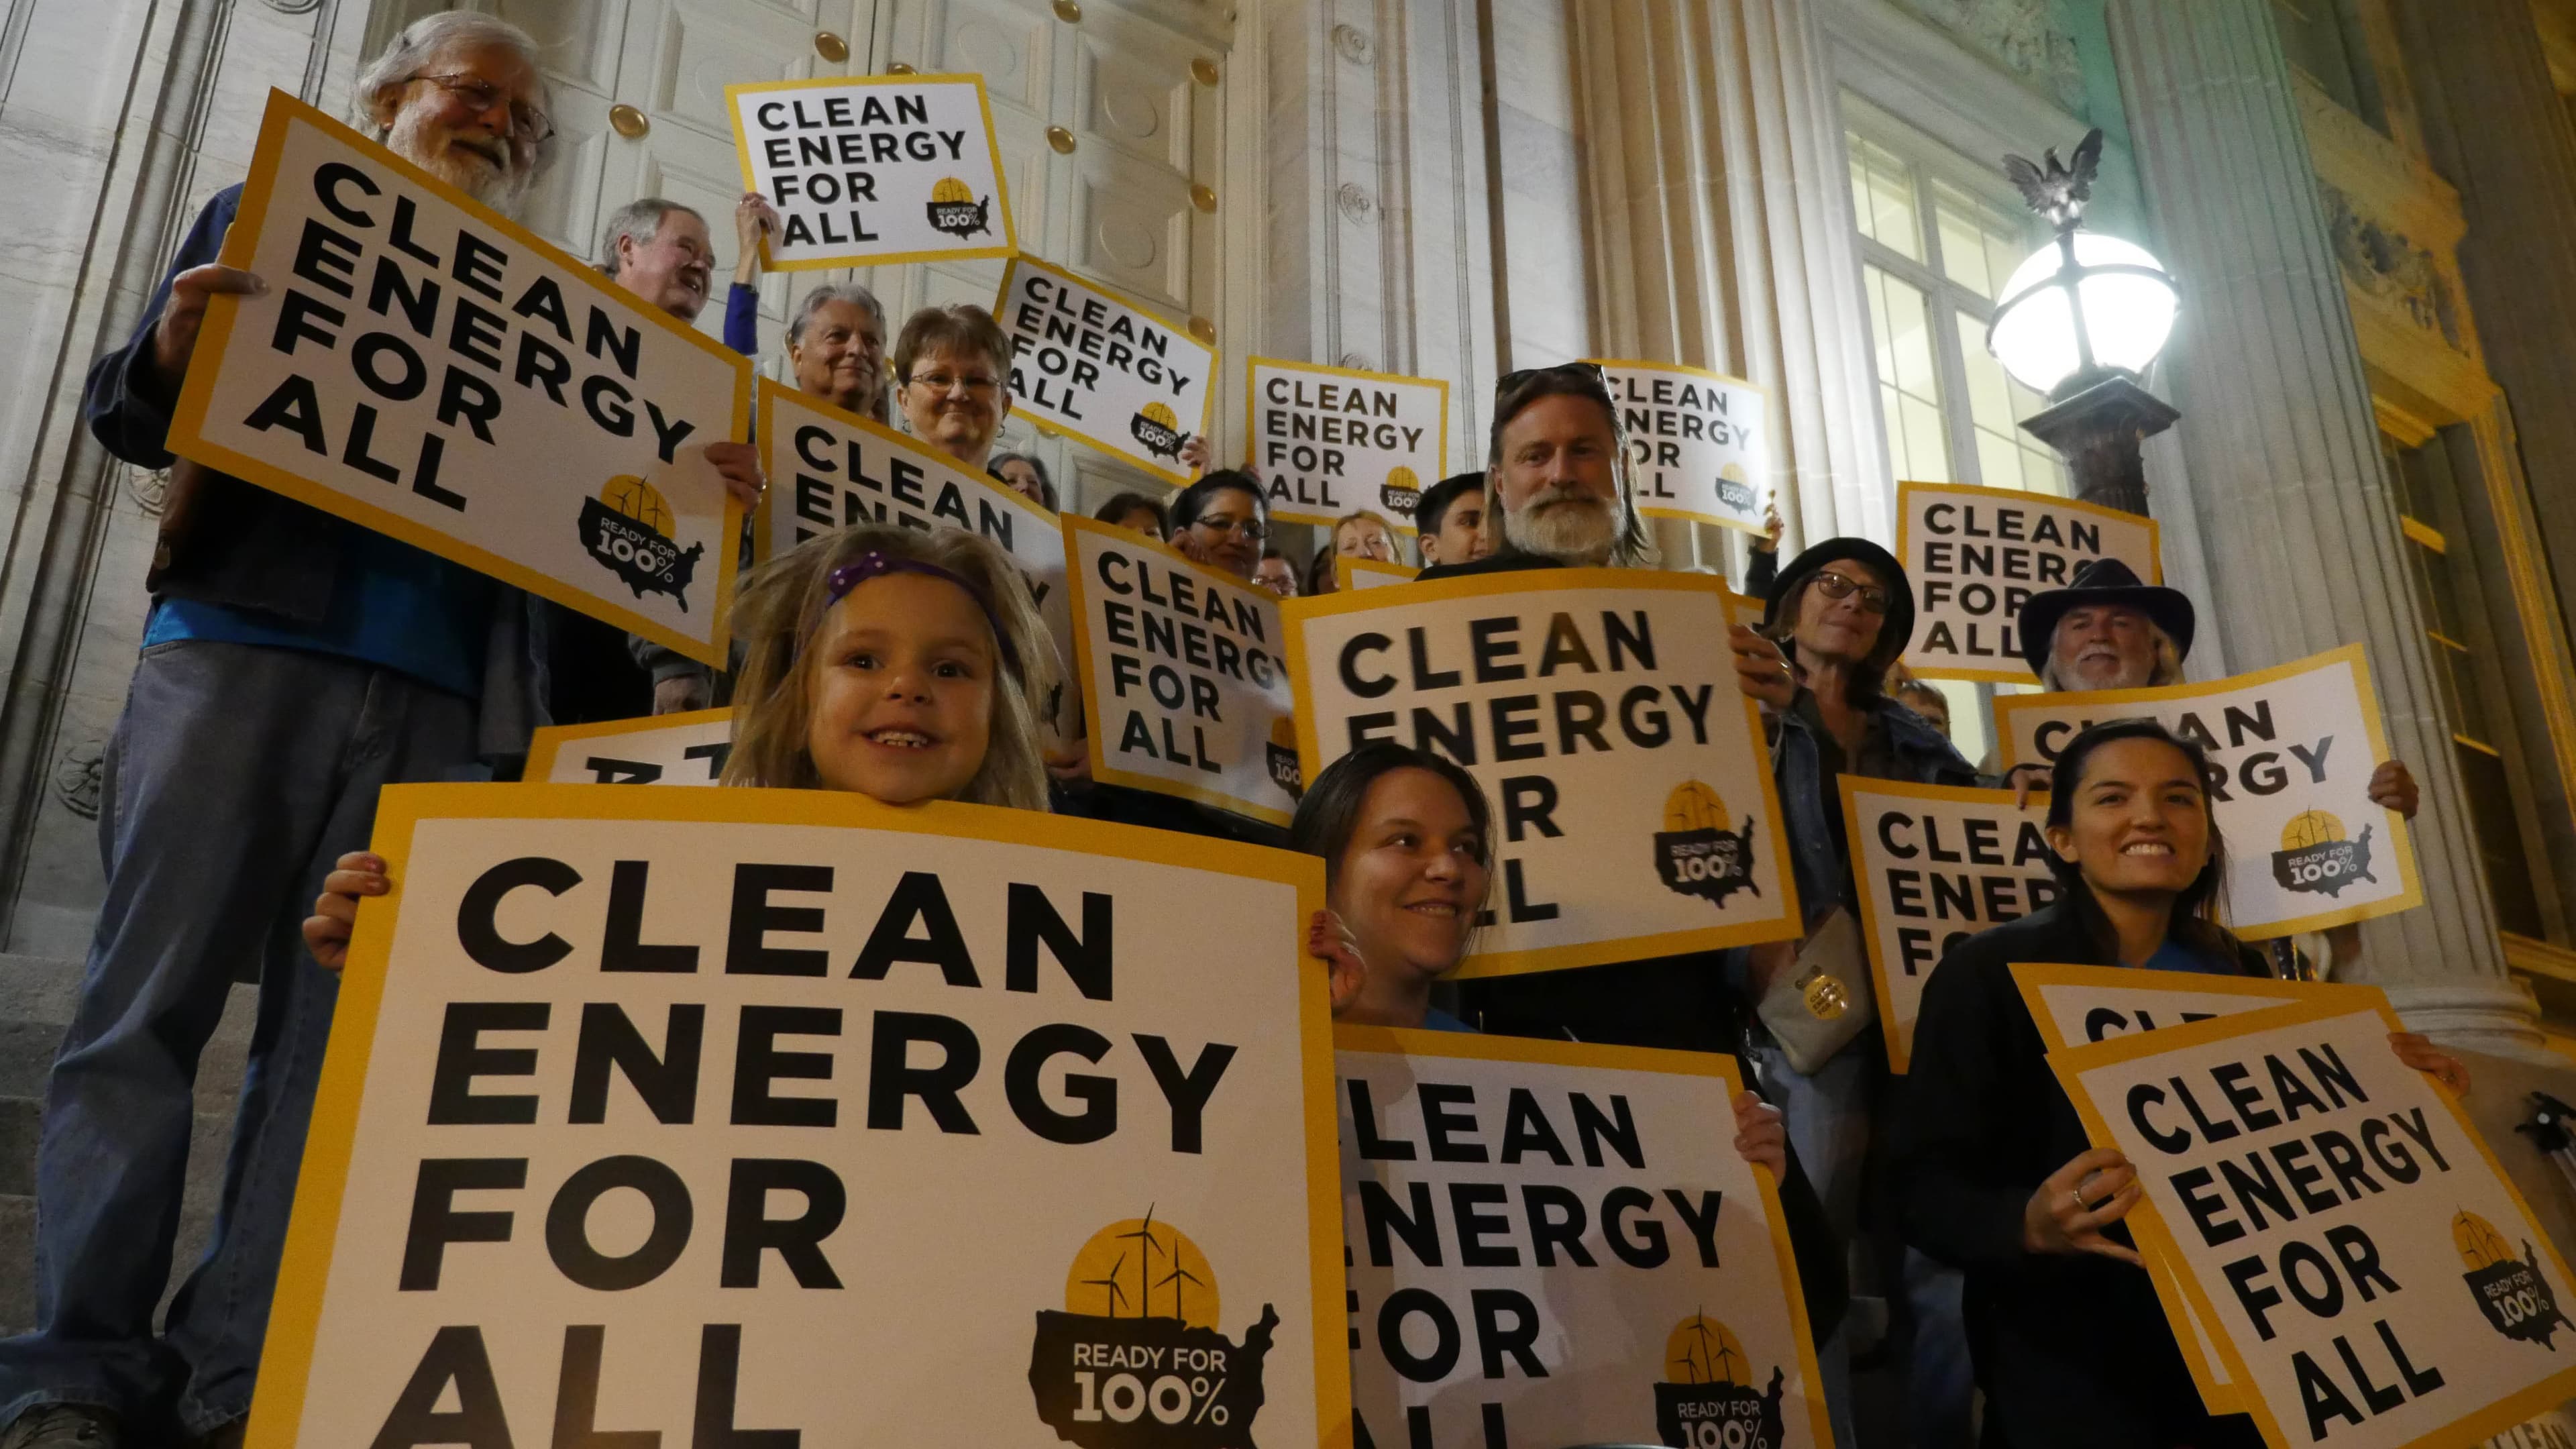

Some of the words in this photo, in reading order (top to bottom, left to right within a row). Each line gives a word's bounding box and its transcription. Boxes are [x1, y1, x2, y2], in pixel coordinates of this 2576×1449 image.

[757, 95, 928, 131] CLEAN
[764, 130, 965, 168] ENERGY
[772, 172, 878, 207] FOR
[783, 210, 879, 247] ALL
[938, 215, 980, 227] 100%
[313, 162, 641, 380] CLEAN
[292, 217, 695, 464] ENERGY
[1026, 277, 1168, 358] CLEAN
[271, 290, 502, 445] FOR
[1012, 333, 1099, 392] FOR
[1016, 303, 1191, 396] ENERGY
[1008, 367, 1082, 421] ALL
[1267, 378, 1397, 419] CLEAN
[243, 374, 468, 513] ALL
[1138, 427, 1175, 451] 100%
[1141, 421, 1162, 434] READY
[1163, 431, 1176, 441] FOR
[1267, 409, 1424, 453] ENERGY
[1624, 409, 1750, 451] NERGY
[1631, 439, 1680, 468] OR
[1268, 441, 1345, 476] FOR
[795, 425, 1013, 553] CLEAN
[1268, 474, 1340, 507] ALL
[597, 529, 675, 583] 100%
[601, 517, 646, 545] READY
[649, 540, 676, 561] FOR
[1924, 503, 2100, 555] CLEAN
[1925, 541, 2093, 585] ENER
[1097, 551, 1266, 643] CLEAN
[1338, 610, 1657, 699] CLEAN
[1921, 621, 2025, 658] ALL
[1111, 653, 1222, 722] FOR
[1120, 709, 1221, 774] ALL
[2034, 700, 2276, 761] CAN
[1276, 763, 1301, 785] 100
[2207, 735, 2334, 802] RGY
[1878, 811, 2051, 867] CLEA
[2288, 851, 2325, 867] READY
[2329, 846, 2353, 858] FOR
[1673, 853, 1743, 882] 100%
[2290, 855, 2357, 885] 100%
[1886, 868, 2057, 924] ENER
[457, 856, 1113, 1002] CLEAN
[426, 1001, 1238, 1155] ENERGY
[2127, 1043, 2369, 1155] CLEAN
[1346, 1079, 1646, 1169] LEAN
[2169, 1107, 2451, 1247] ENERGY
[398, 1153, 847, 1292] FOR
[1344, 1180, 1723, 1269] NERGY
[2222, 1224, 2402, 1342] FOR
[2483, 1277, 2514, 1299] READY
[2512, 1271, 2533, 1287] FOR
[2492, 1285, 2549, 1327] 100%
[1074, 1343, 1165, 1370] READY
[1174, 1348, 1227, 1373] FOR
[2292, 1319, 2446, 1442] ALL
[369, 1324, 803, 1449] ALL
[1073, 1372, 1229, 1426] 100%
[1678, 1401, 1726, 1418] READY
[1731, 1401, 1760, 1415] FOR
[1681, 1419, 1767, 1449] 100%
